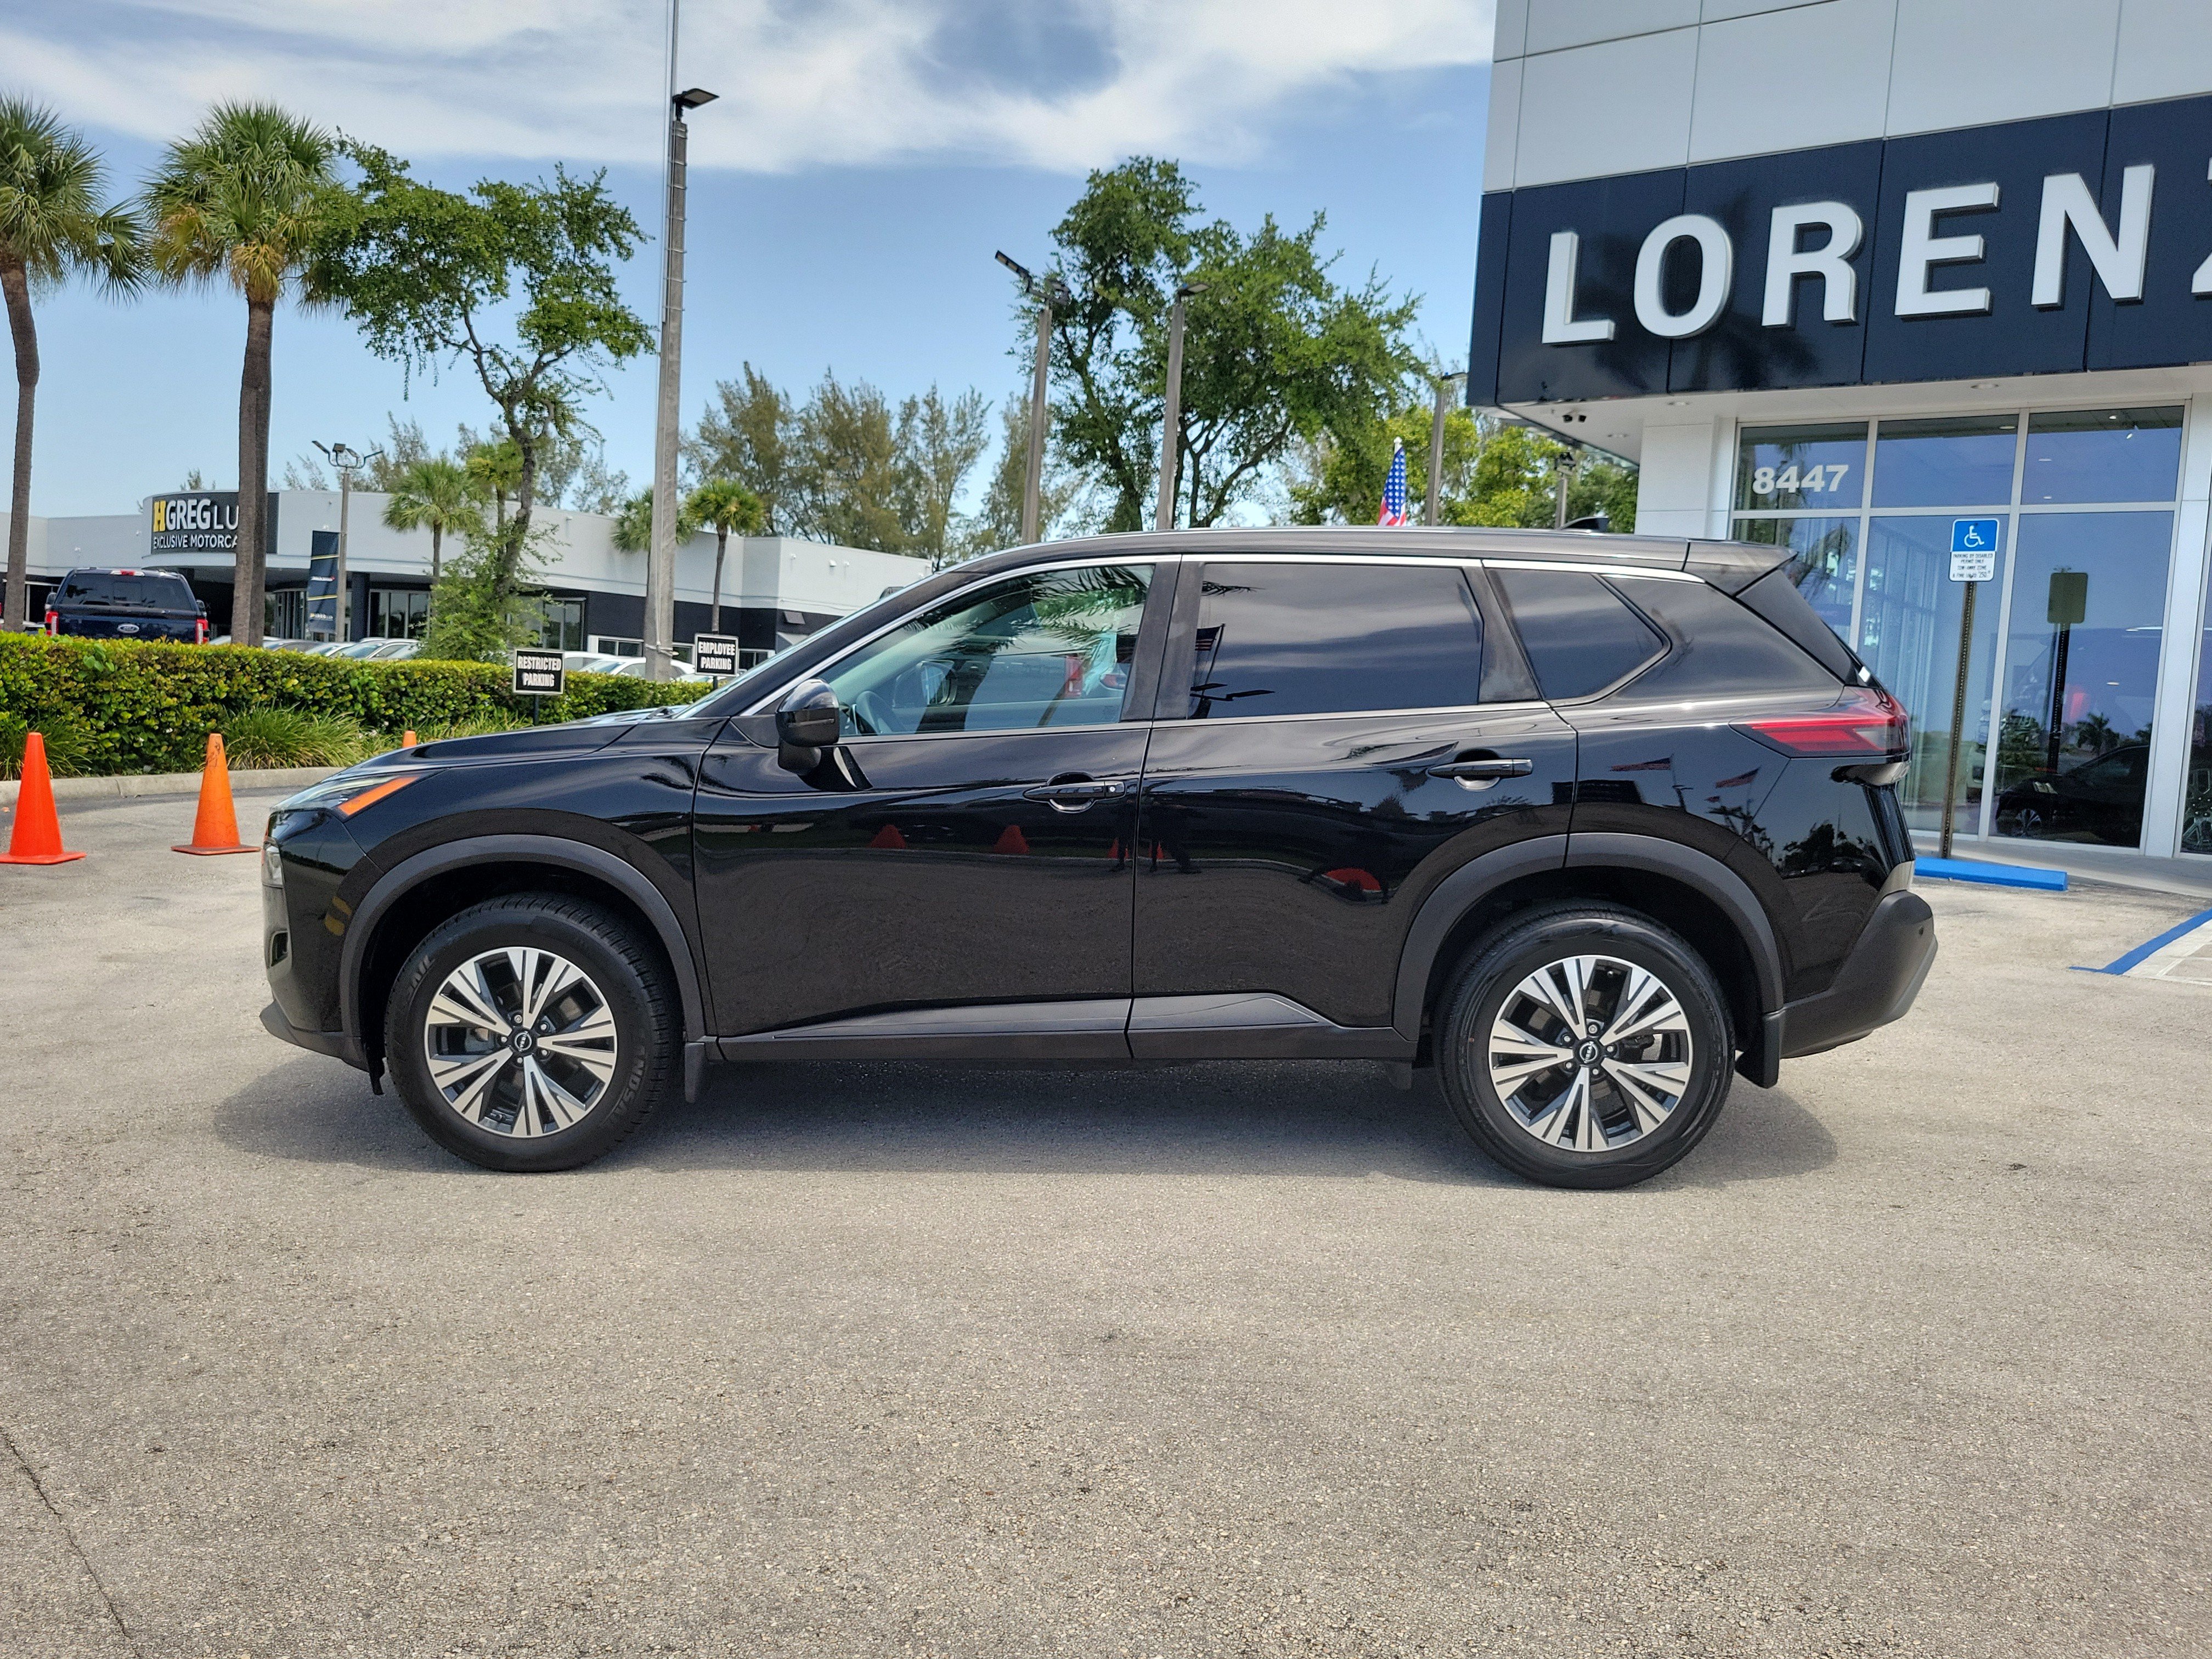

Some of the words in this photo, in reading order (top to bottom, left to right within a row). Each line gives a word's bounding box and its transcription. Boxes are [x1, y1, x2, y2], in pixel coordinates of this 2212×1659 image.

[1542, 156, 2212, 345] LOREN
[1752, 465, 1849, 494] 8447
[153, 534, 188, 549] EXCLUSIVE
[190, 533, 238, 549] MOTORCA
[698, 641, 735, 656] EMPLOYEE
[517, 655, 562, 671] RESTRICTED
[701, 656, 732, 670] PARKING
[522, 672, 555, 687] PARKING
